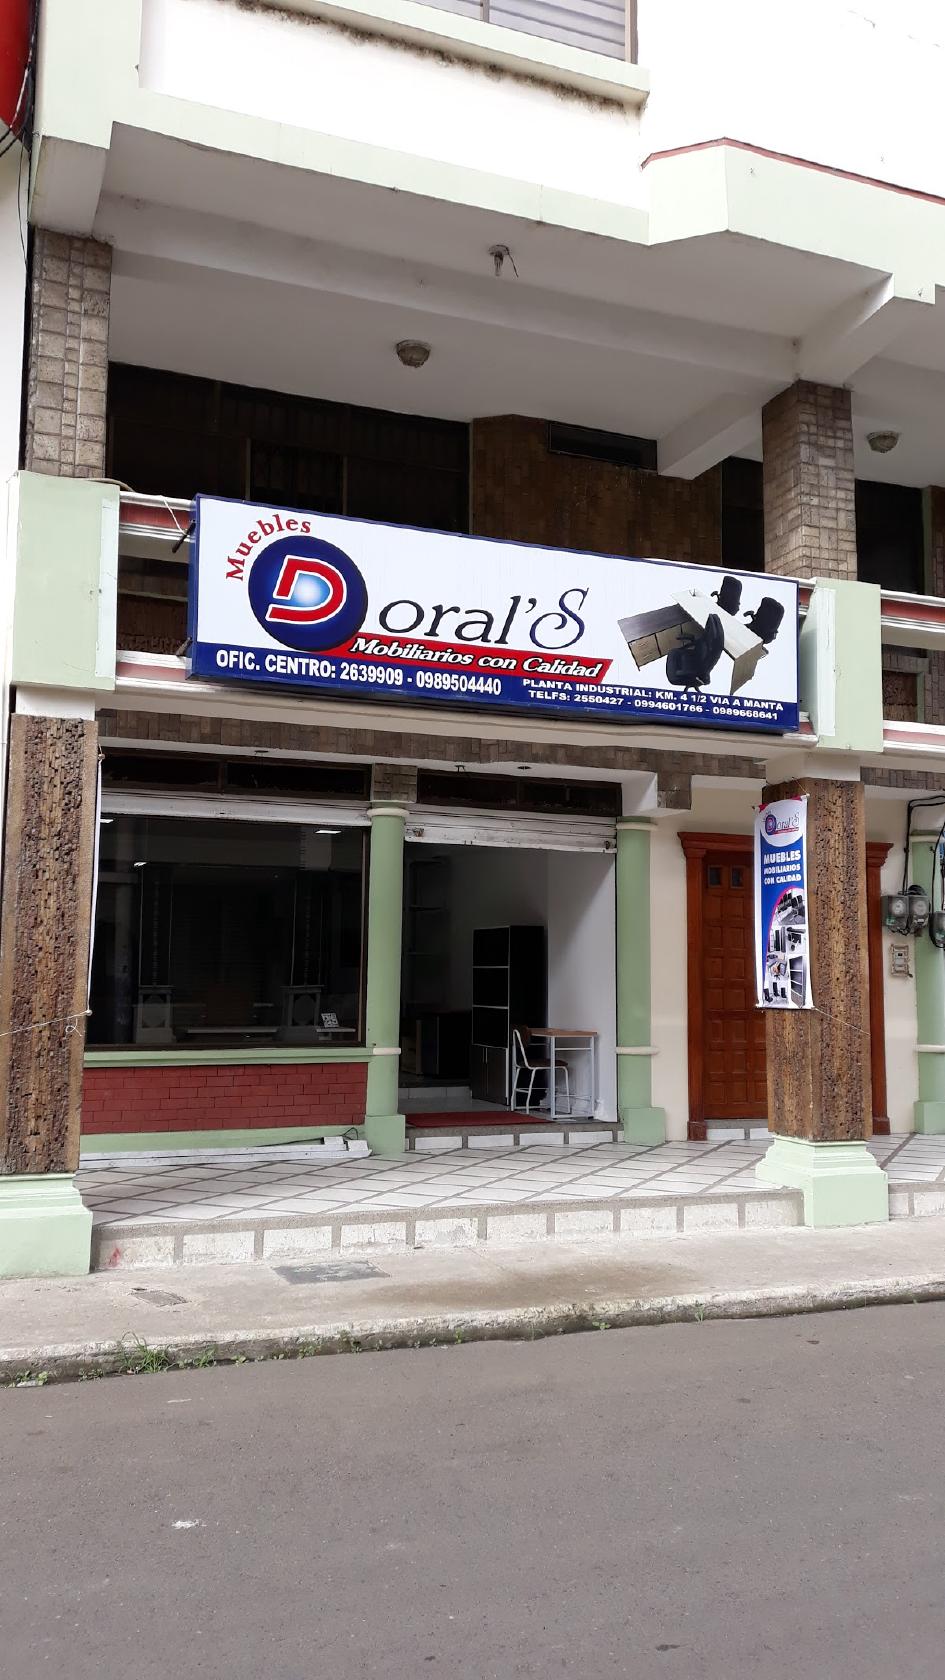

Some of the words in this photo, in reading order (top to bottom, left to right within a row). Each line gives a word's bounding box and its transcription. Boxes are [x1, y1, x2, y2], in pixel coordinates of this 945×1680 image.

[226, 514, 312, 581] Muebles
[350, 637, 474, 665] Mobiliarios
[478, 656, 517, 670] con
[522, 657, 603, 677] Calidad
[216, 649, 260, 671] OFIC.
[264, 654, 336, 679] CENTRO:
[339, 661, 404, 686] 2639909
[416, 670, 502, 696] 0989504440
[522, 678, 573, 691] PLANTA
[575, 683, 652, 698] INDUSTRIAL:
[655, 690, 677, 700] KM.
[680, 693, 688, 701] 4
[690, 694, 707, 703] 1/2
[709, 695, 730, 705] VIA
[732, 698, 741, 707] A
[743, 699, 784, 711] MANTA
[528, 689, 571, 701] TELFS:
[574, 694, 624, 706] 2550427
[634, 699, 703, 713] 0994601766
[763, 850, 802, 865] MUEBLES
[763, 864, 801, 875] MOBILIARIOS
[764, 877, 775, 885] CON
[776, 873, 802, 884] CALIDAD
